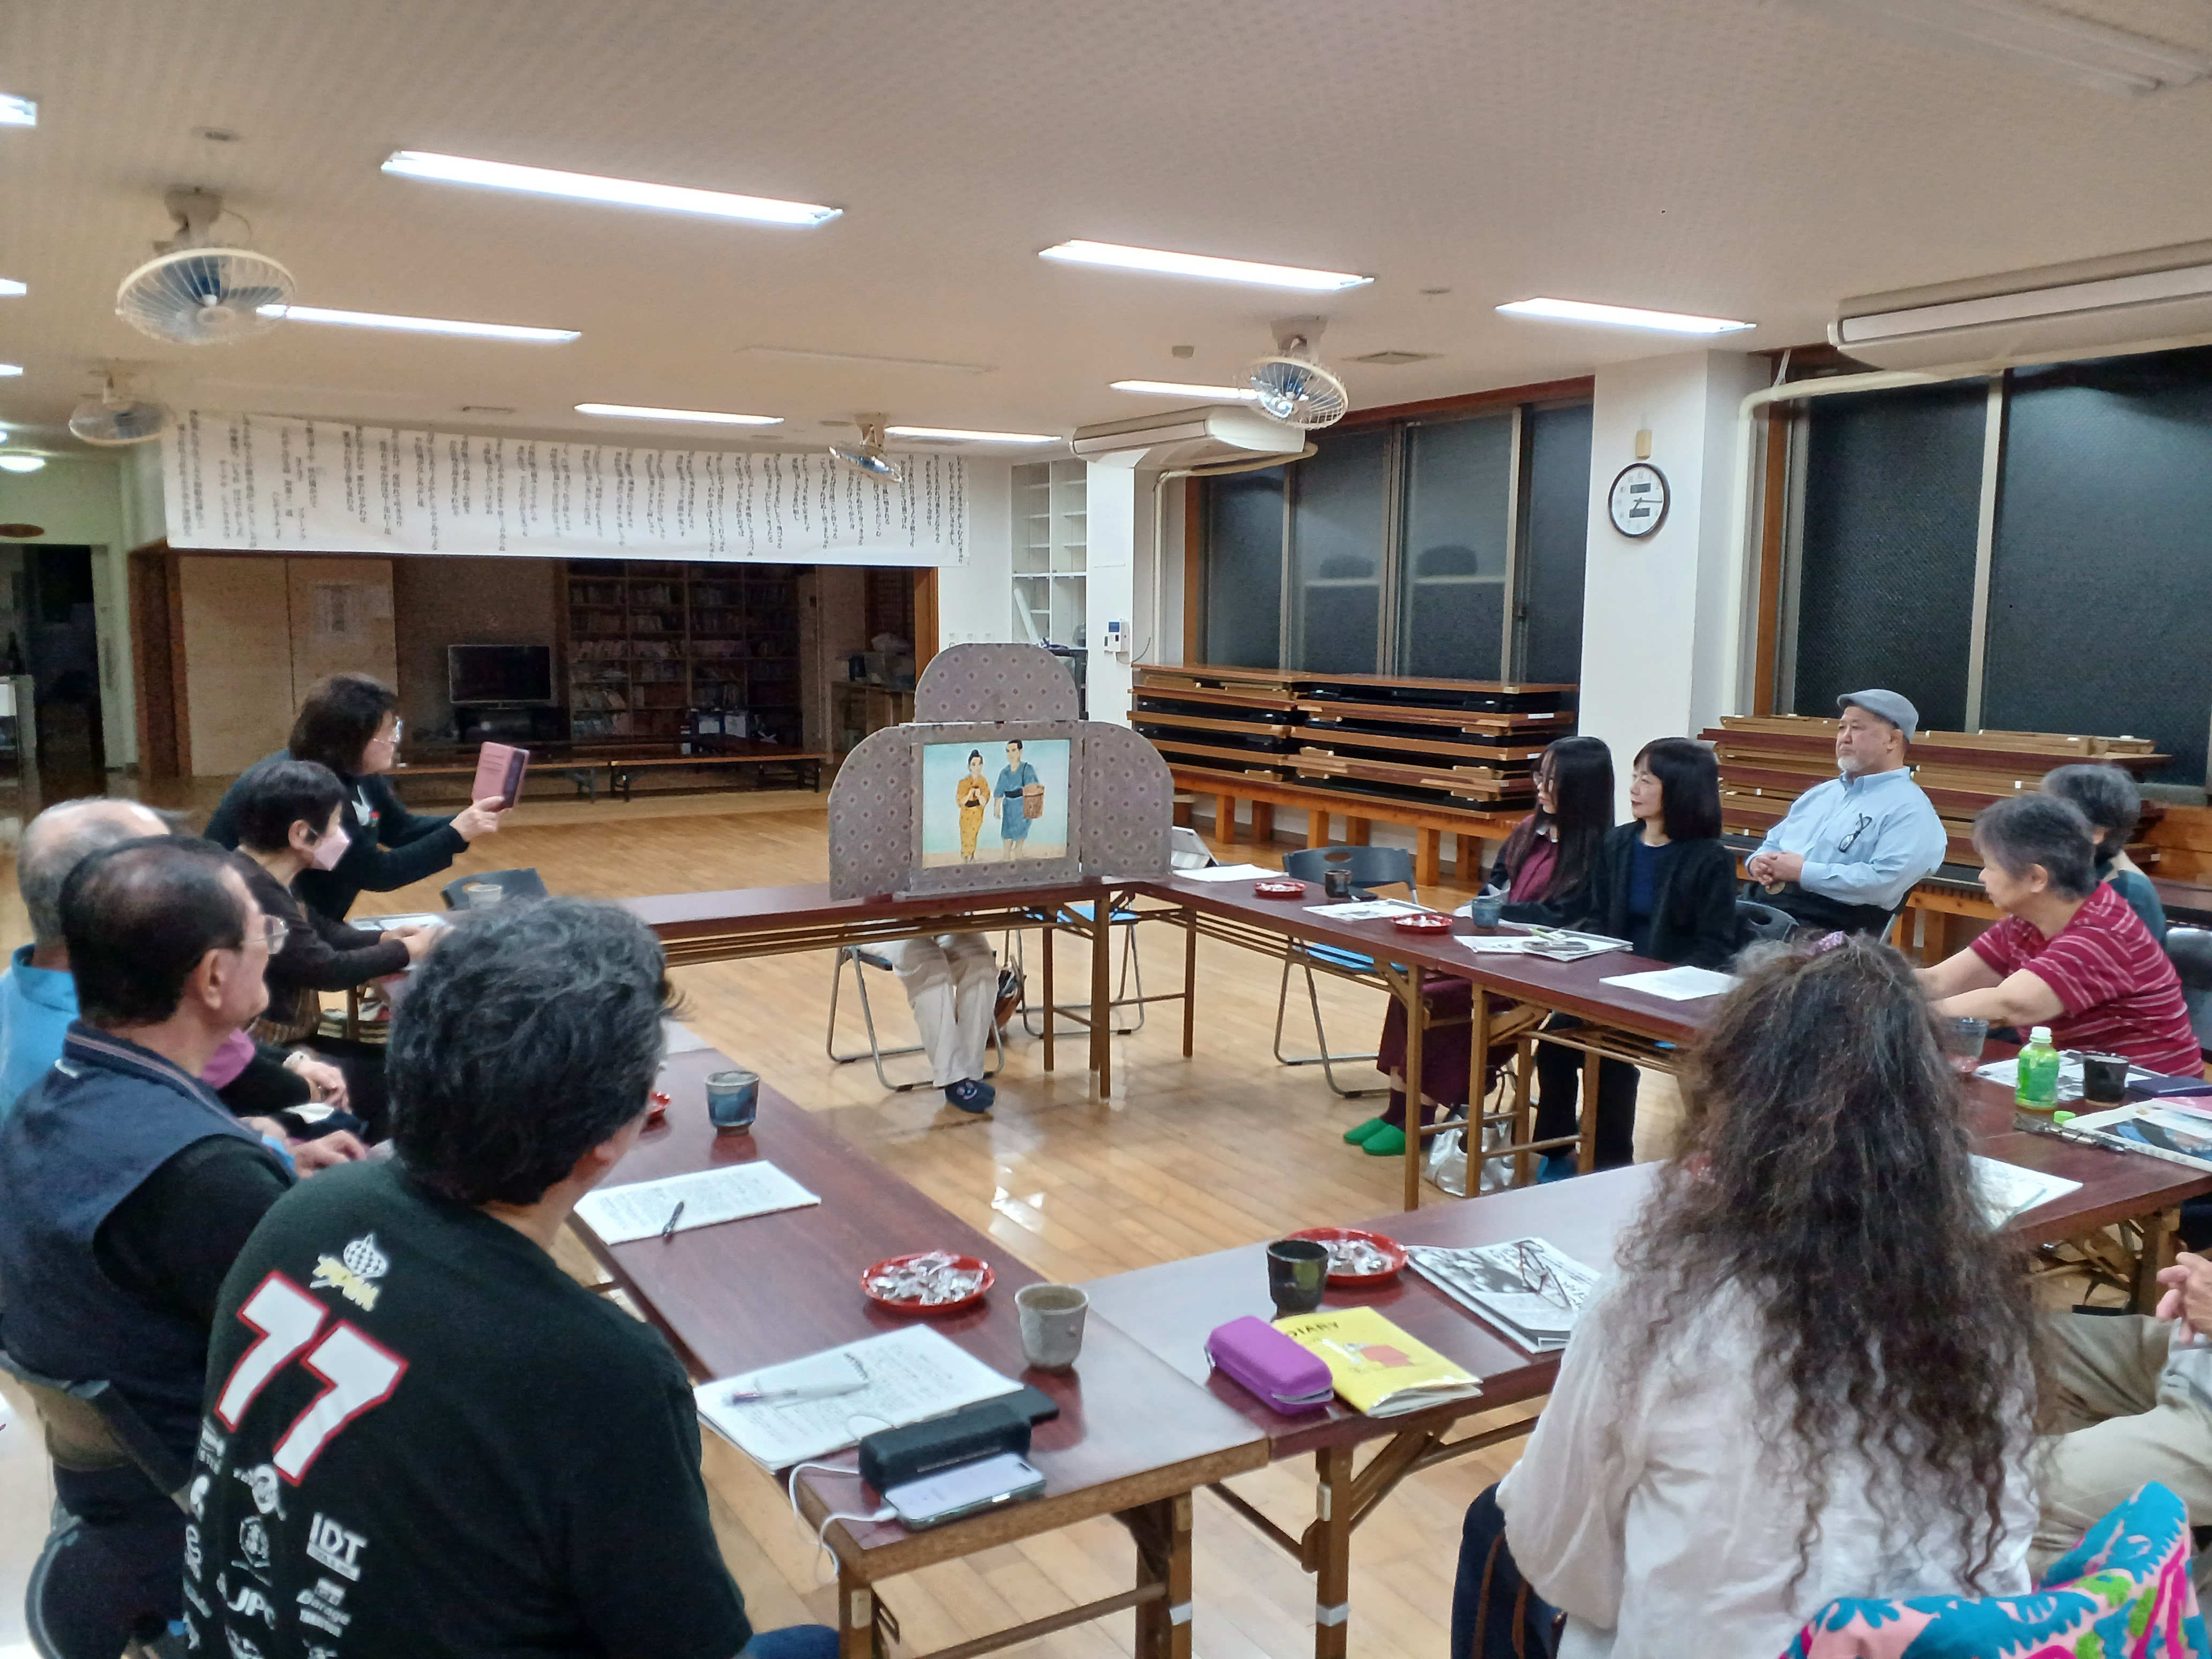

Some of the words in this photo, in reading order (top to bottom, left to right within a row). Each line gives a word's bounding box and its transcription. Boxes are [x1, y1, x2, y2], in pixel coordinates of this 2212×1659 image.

[1284, 1321, 1339, 1337] DIARY
[214, 1270, 409, 1486] 77
[309, 1512, 368, 1565] IDT
